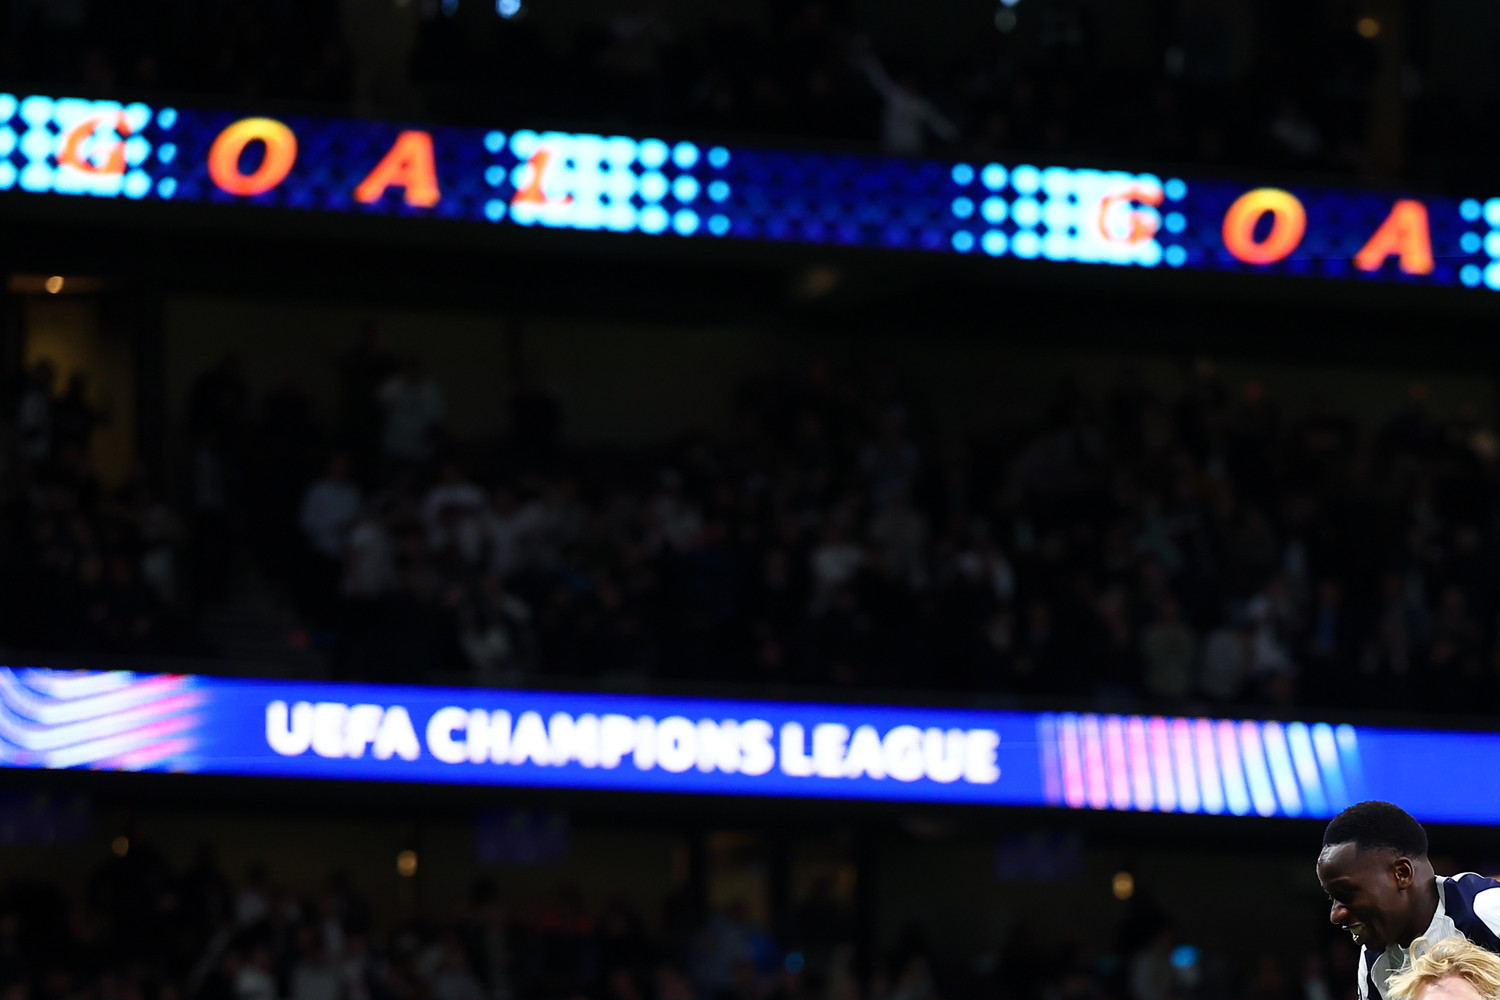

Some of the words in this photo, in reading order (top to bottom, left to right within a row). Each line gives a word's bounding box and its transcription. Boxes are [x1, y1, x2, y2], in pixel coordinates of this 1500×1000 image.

[266, 701, 421, 761] UEFA
[426, 706, 776, 777] CHAMPIONS
[780, 721, 1001, 784] LEAGUE
